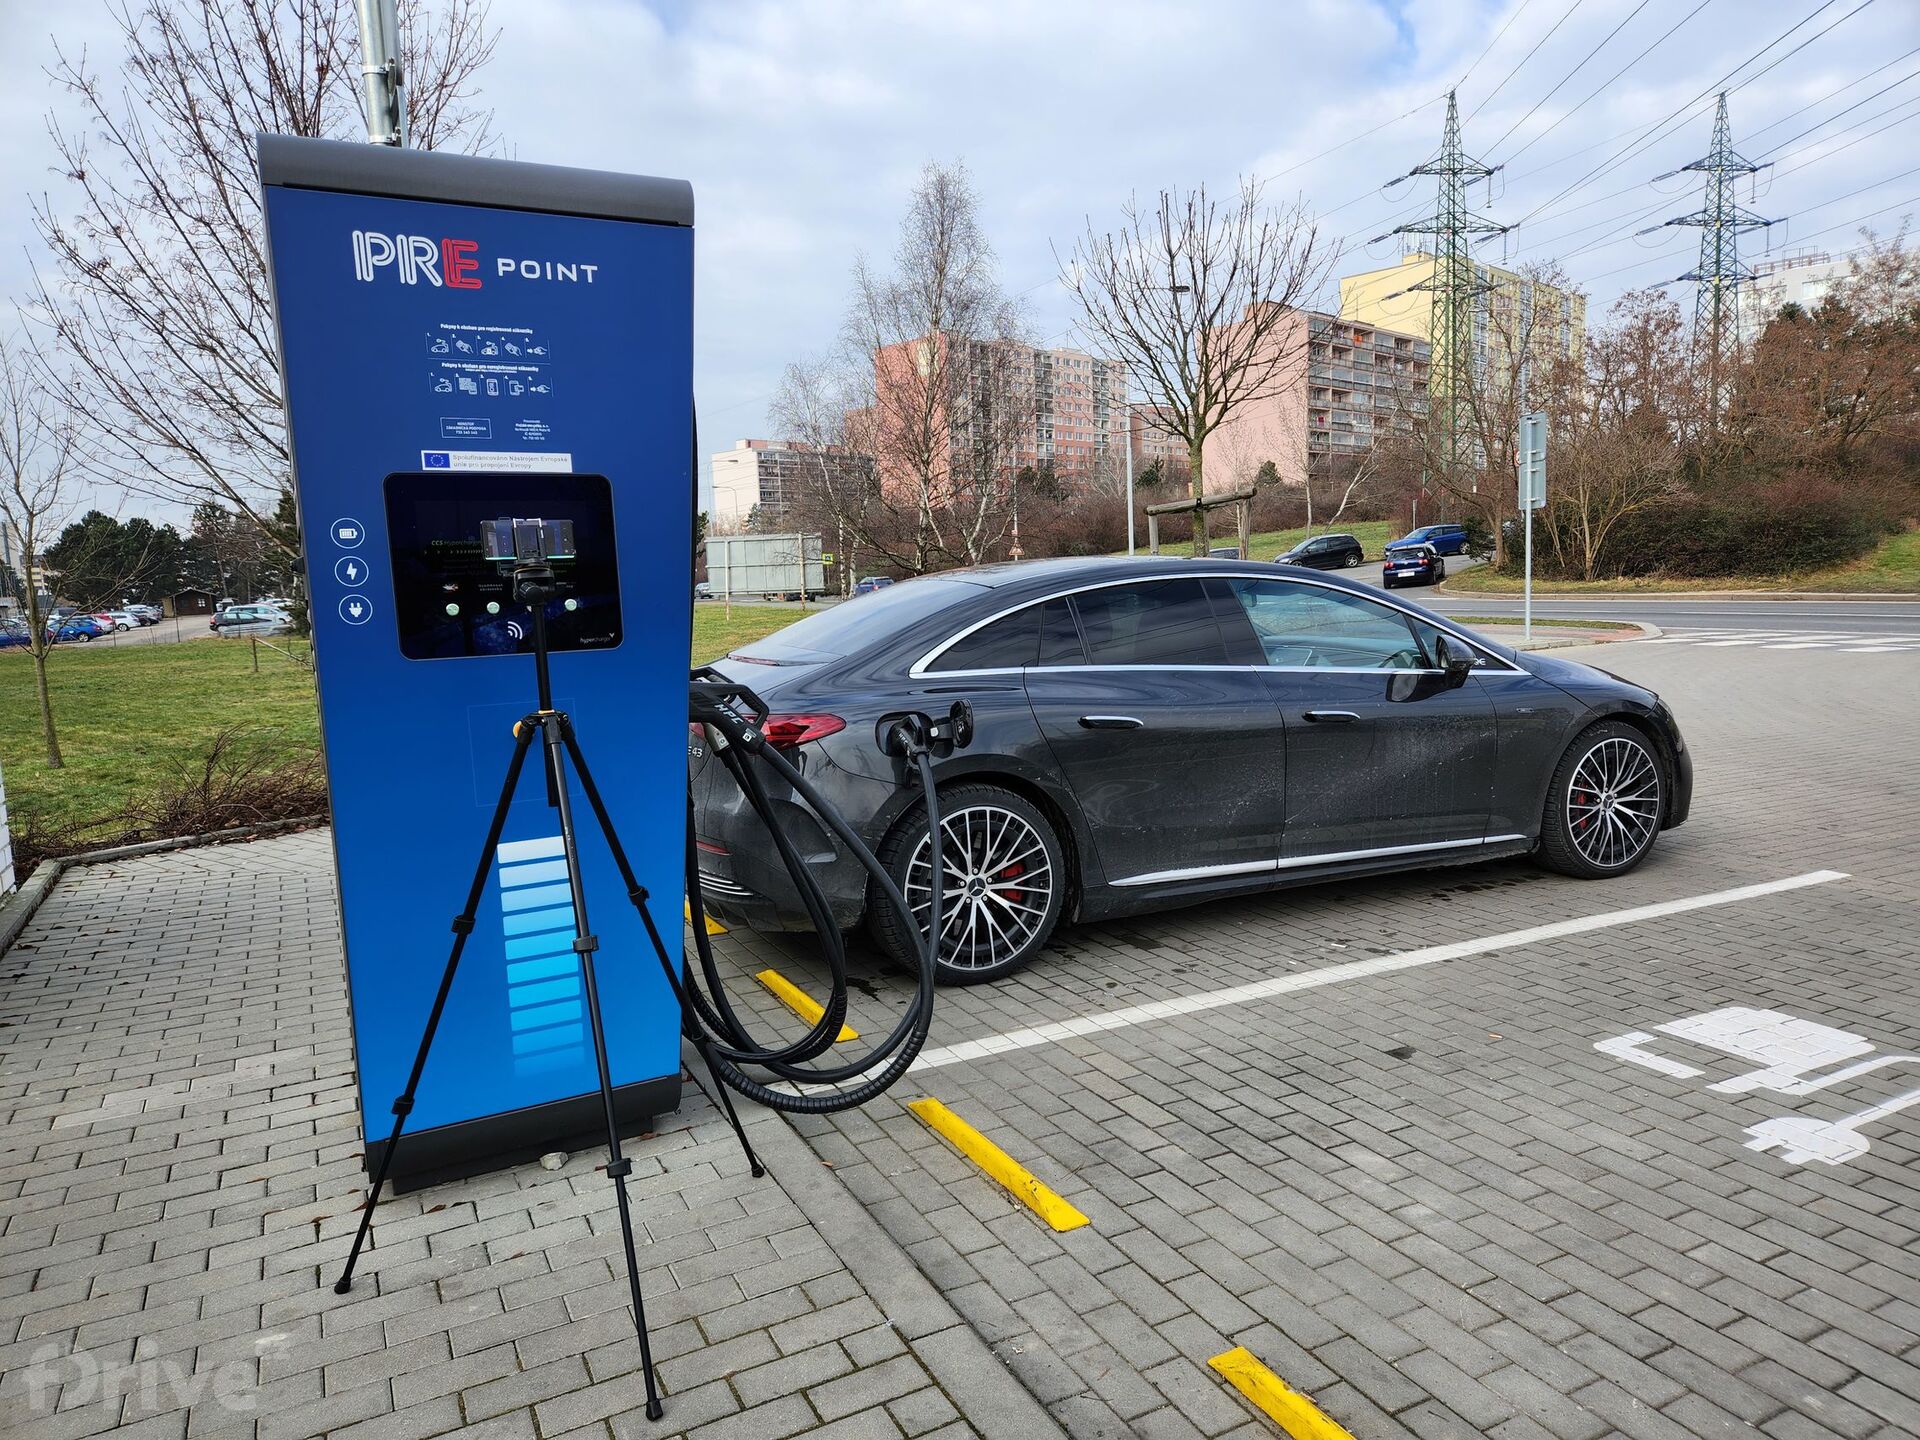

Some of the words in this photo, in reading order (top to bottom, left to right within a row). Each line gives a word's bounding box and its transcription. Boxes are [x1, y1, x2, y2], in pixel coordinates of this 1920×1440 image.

[352, 230, 482, 289] PRE
[497, 257, 598, 284] POINT
[508, 455, 540, 463] Nástrojem
[714, 703, 744, 724] HPC
